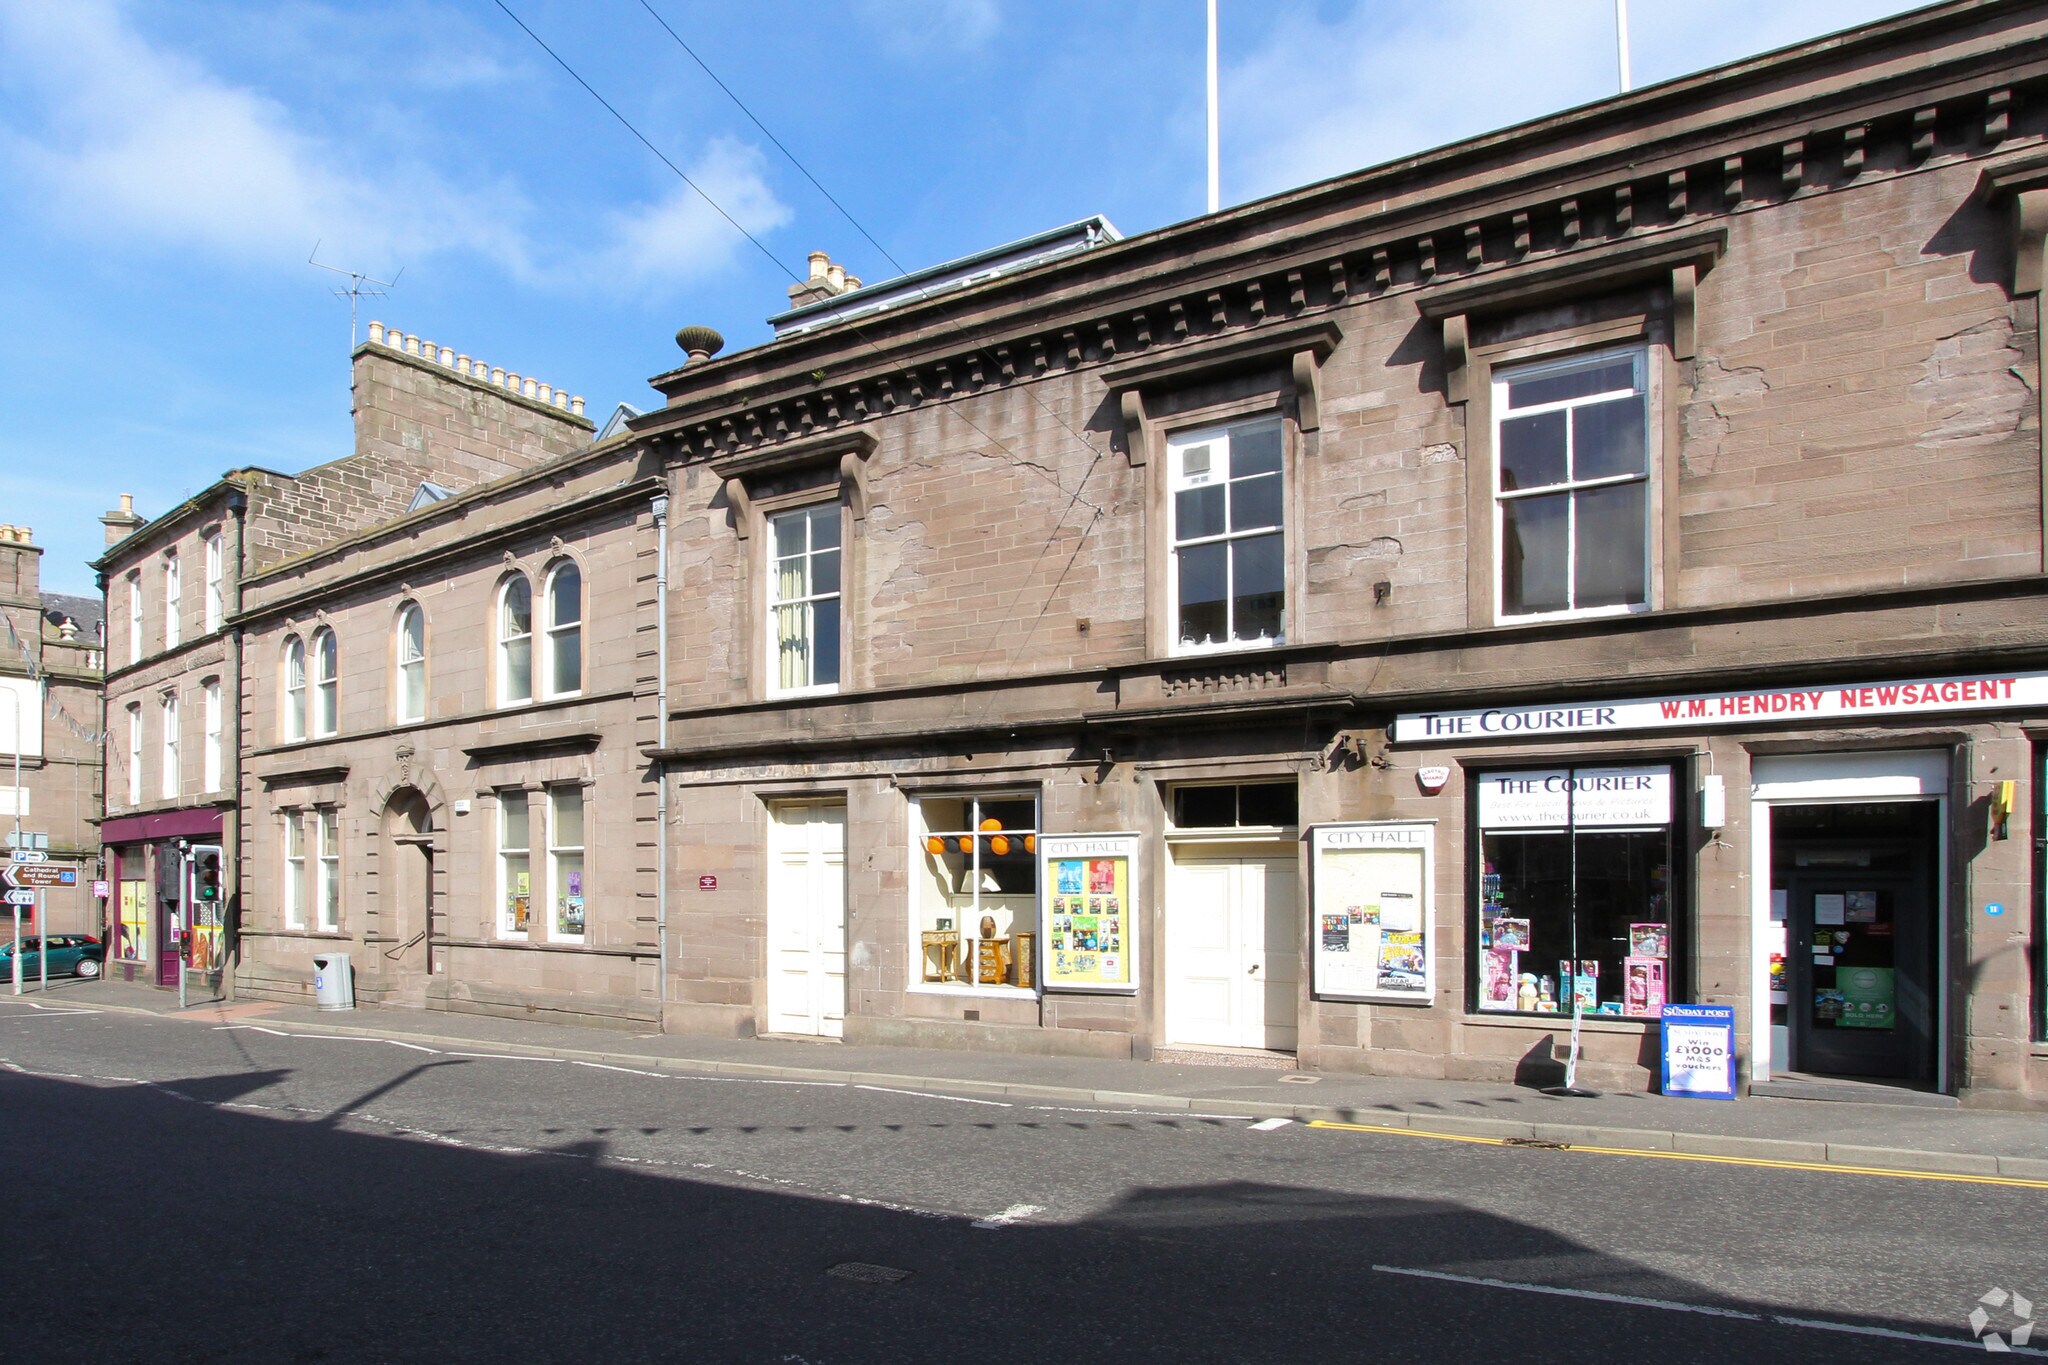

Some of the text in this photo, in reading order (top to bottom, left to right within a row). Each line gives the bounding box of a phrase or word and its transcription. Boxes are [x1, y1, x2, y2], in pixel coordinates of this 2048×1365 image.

[1660, 679, 2017, 719] W.M. HENDRY NEWSAGENT
[1419, 708, 1616, 735] THE COURIER
[1495, 775, 1652, 794] THE COURIER
[1328, 831, 1419, 843] CITY HALL
[1051, 841, 1122, 853] CITY HALL
[1663, 1006, 1730, 1017] SUNDAY POST
[1675, 1045, 1723, 1056] £1000
[1676, 1063, 1721, 1071] vouchers
